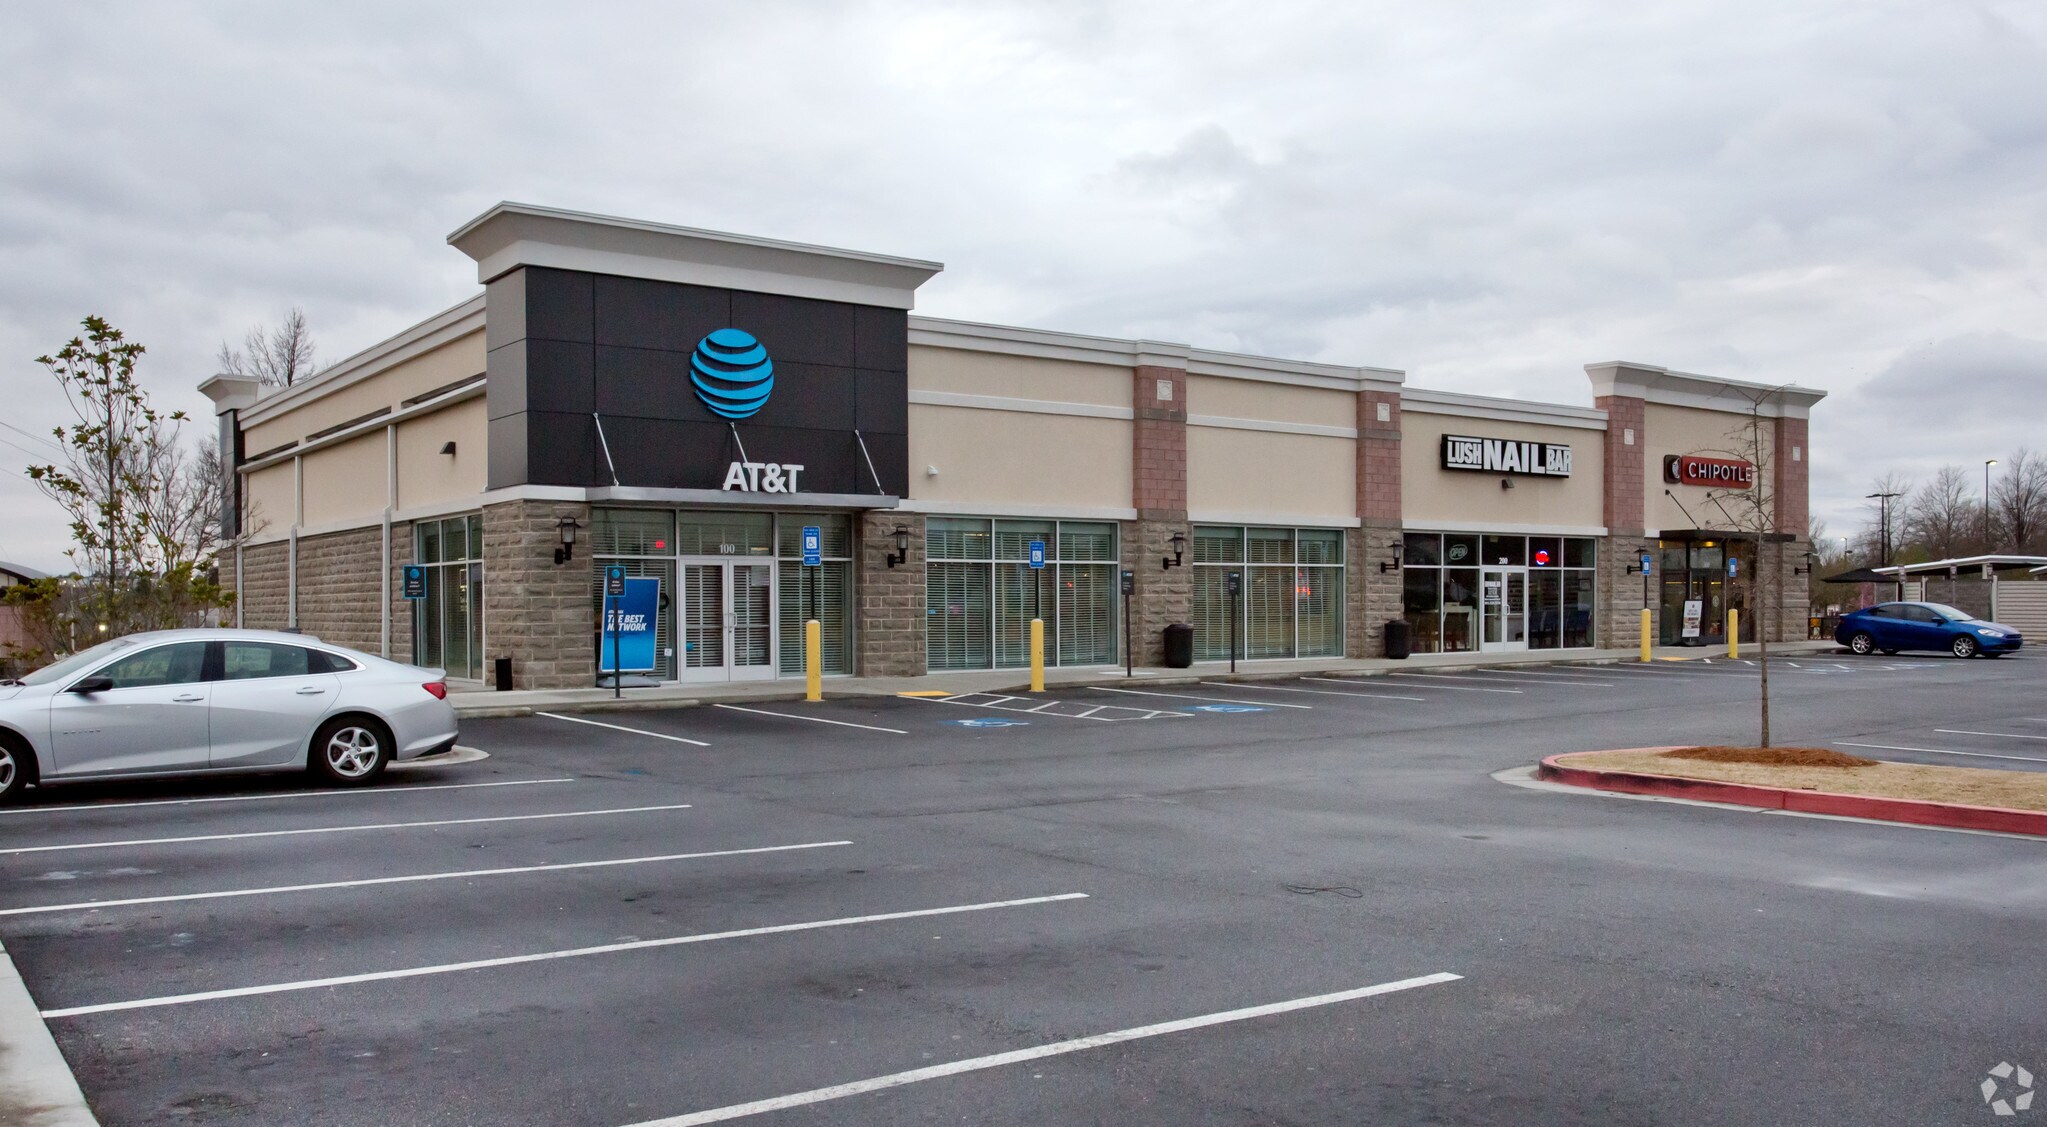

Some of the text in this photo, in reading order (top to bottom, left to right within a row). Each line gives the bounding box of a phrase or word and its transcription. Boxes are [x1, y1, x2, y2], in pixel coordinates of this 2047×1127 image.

[1447, 439, 1571, 474] LUSH NAIL BAR
[722, 461, 804, 494] AT&T
[1688, 462, 1752, 482] CHIPOTLE
[719, 543, 735, 554] 100
[1498, 557, 1508, 565] 200
[624, 614, 645, 623] BEST
[607, 622, 647, 632] NTWORK
